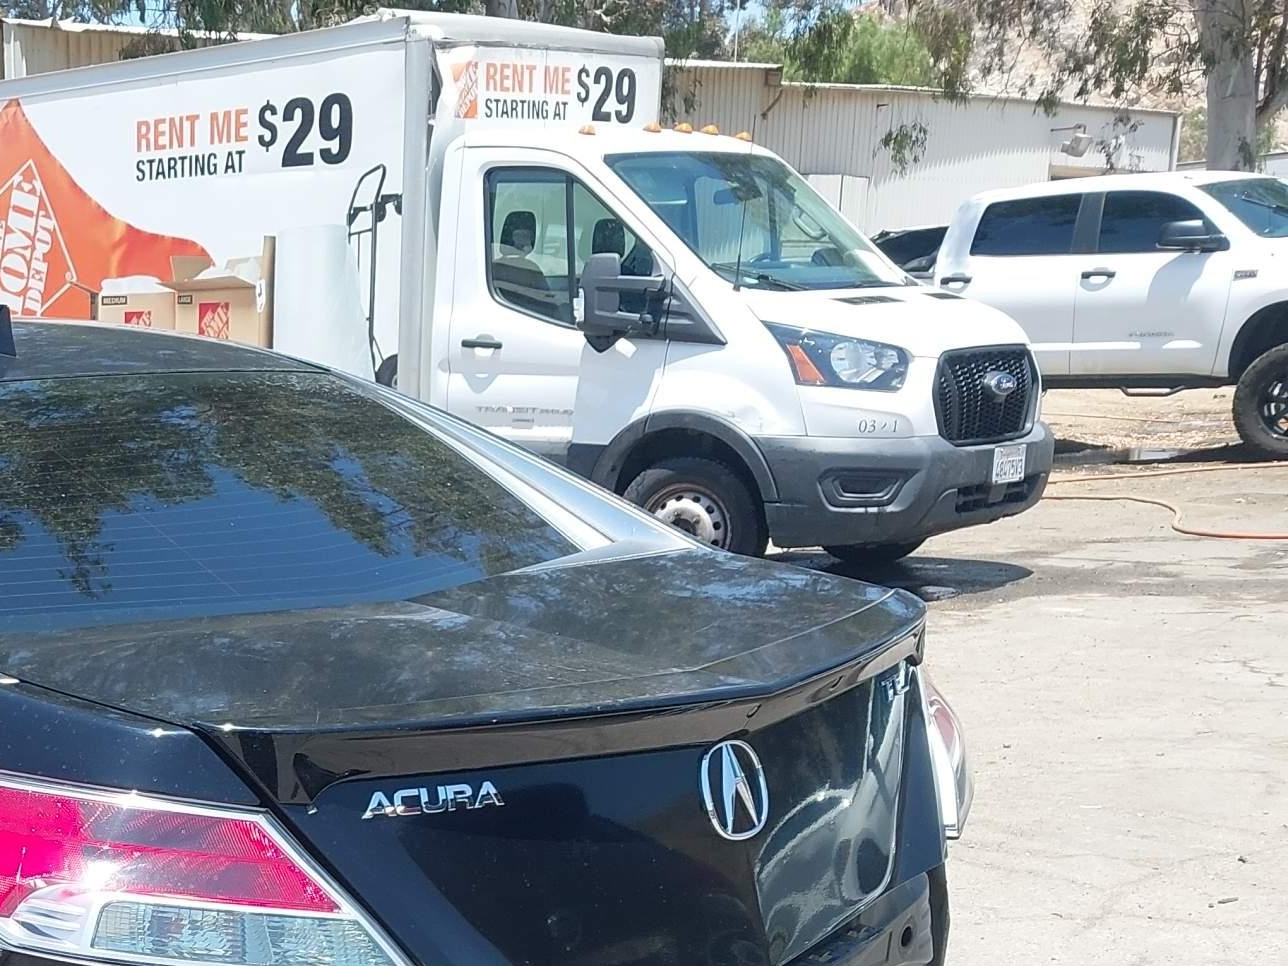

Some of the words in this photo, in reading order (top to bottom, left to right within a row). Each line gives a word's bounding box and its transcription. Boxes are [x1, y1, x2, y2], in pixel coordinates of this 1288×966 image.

[486, 62, 537, 94] RENT
[544, 64, 571, 95] ME
[576, 63, 637, 124] $29
[136, 114, 200, 153] RENT
[209, 108, 249, 145] ME
[257, 92, 353, 168] $29
[484, 98, 549, 119] STARTING
[553, 101, 569, 121] AT
[135, 153, 218, 182] STARTING
[224, 150, 246, 175] AT
[24, 210, 55, 318] DEPOT
[361, 780, 506, 819] ACURA
